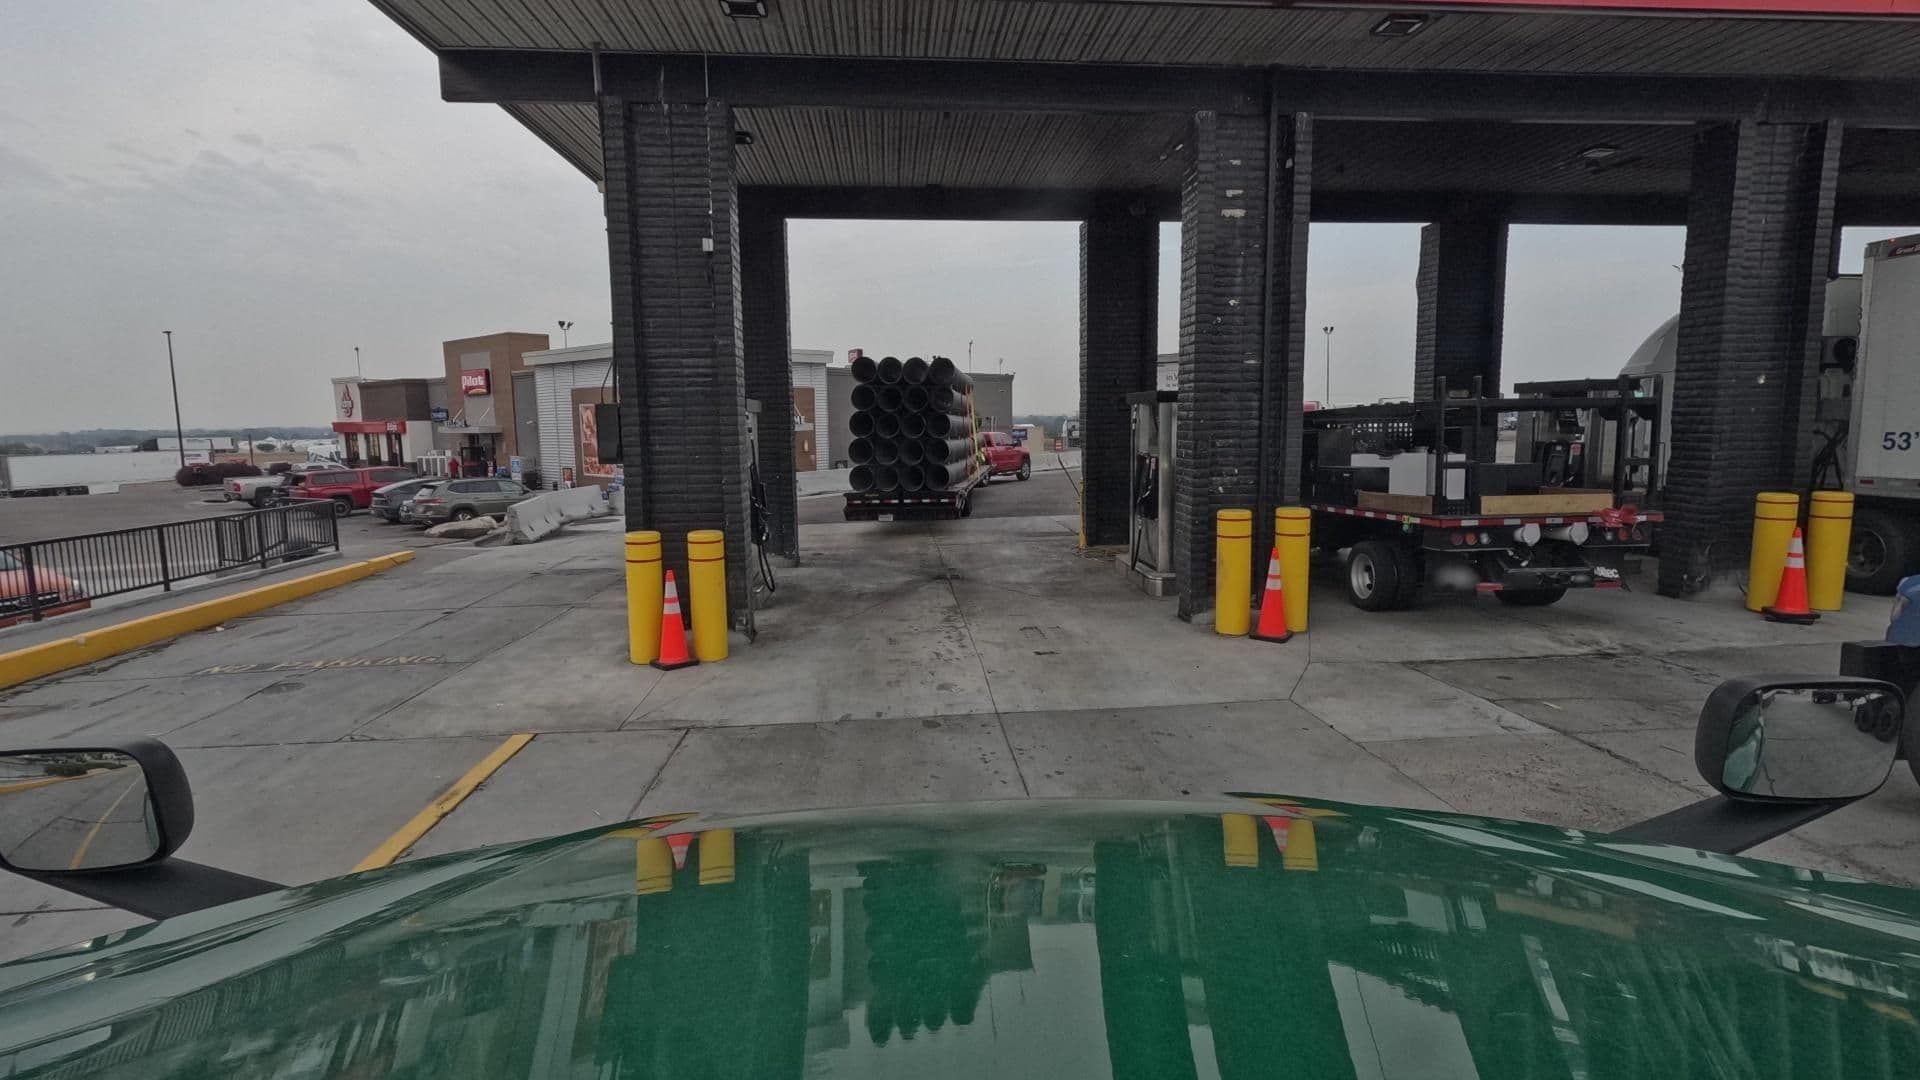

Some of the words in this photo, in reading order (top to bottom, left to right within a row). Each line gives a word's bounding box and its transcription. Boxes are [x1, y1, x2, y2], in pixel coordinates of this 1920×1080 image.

[462, 375, 485, 390] Pilot
[196, 663, 256, 675] NO
[270, 655, 442, 669] PARKING
